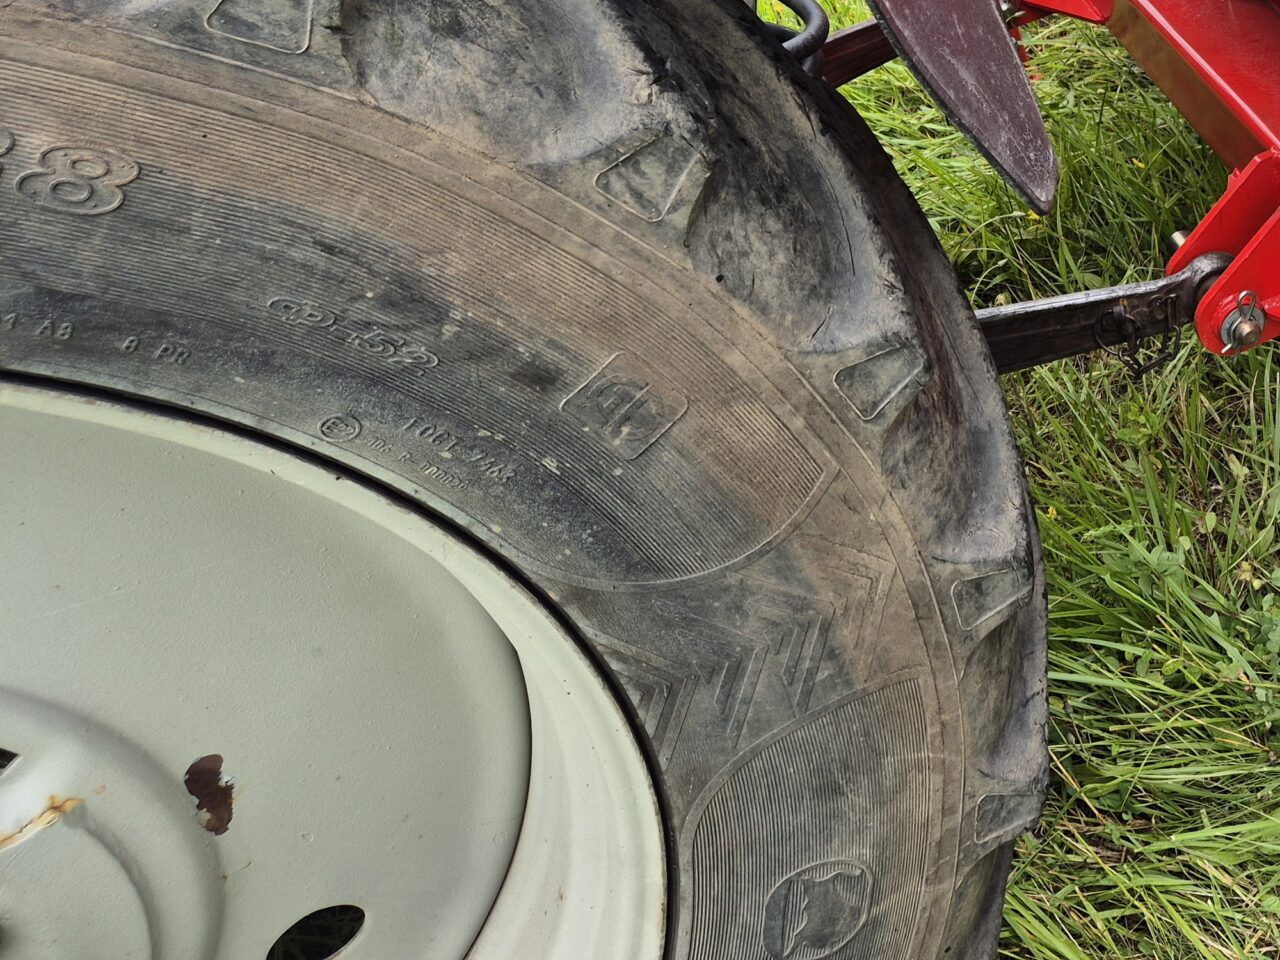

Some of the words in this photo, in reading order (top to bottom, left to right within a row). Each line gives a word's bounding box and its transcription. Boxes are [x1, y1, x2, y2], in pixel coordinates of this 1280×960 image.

[0, 128, 140, 215] 8
[122, 336, 138, 354] 8
[155, 343, 192, 365] PR
